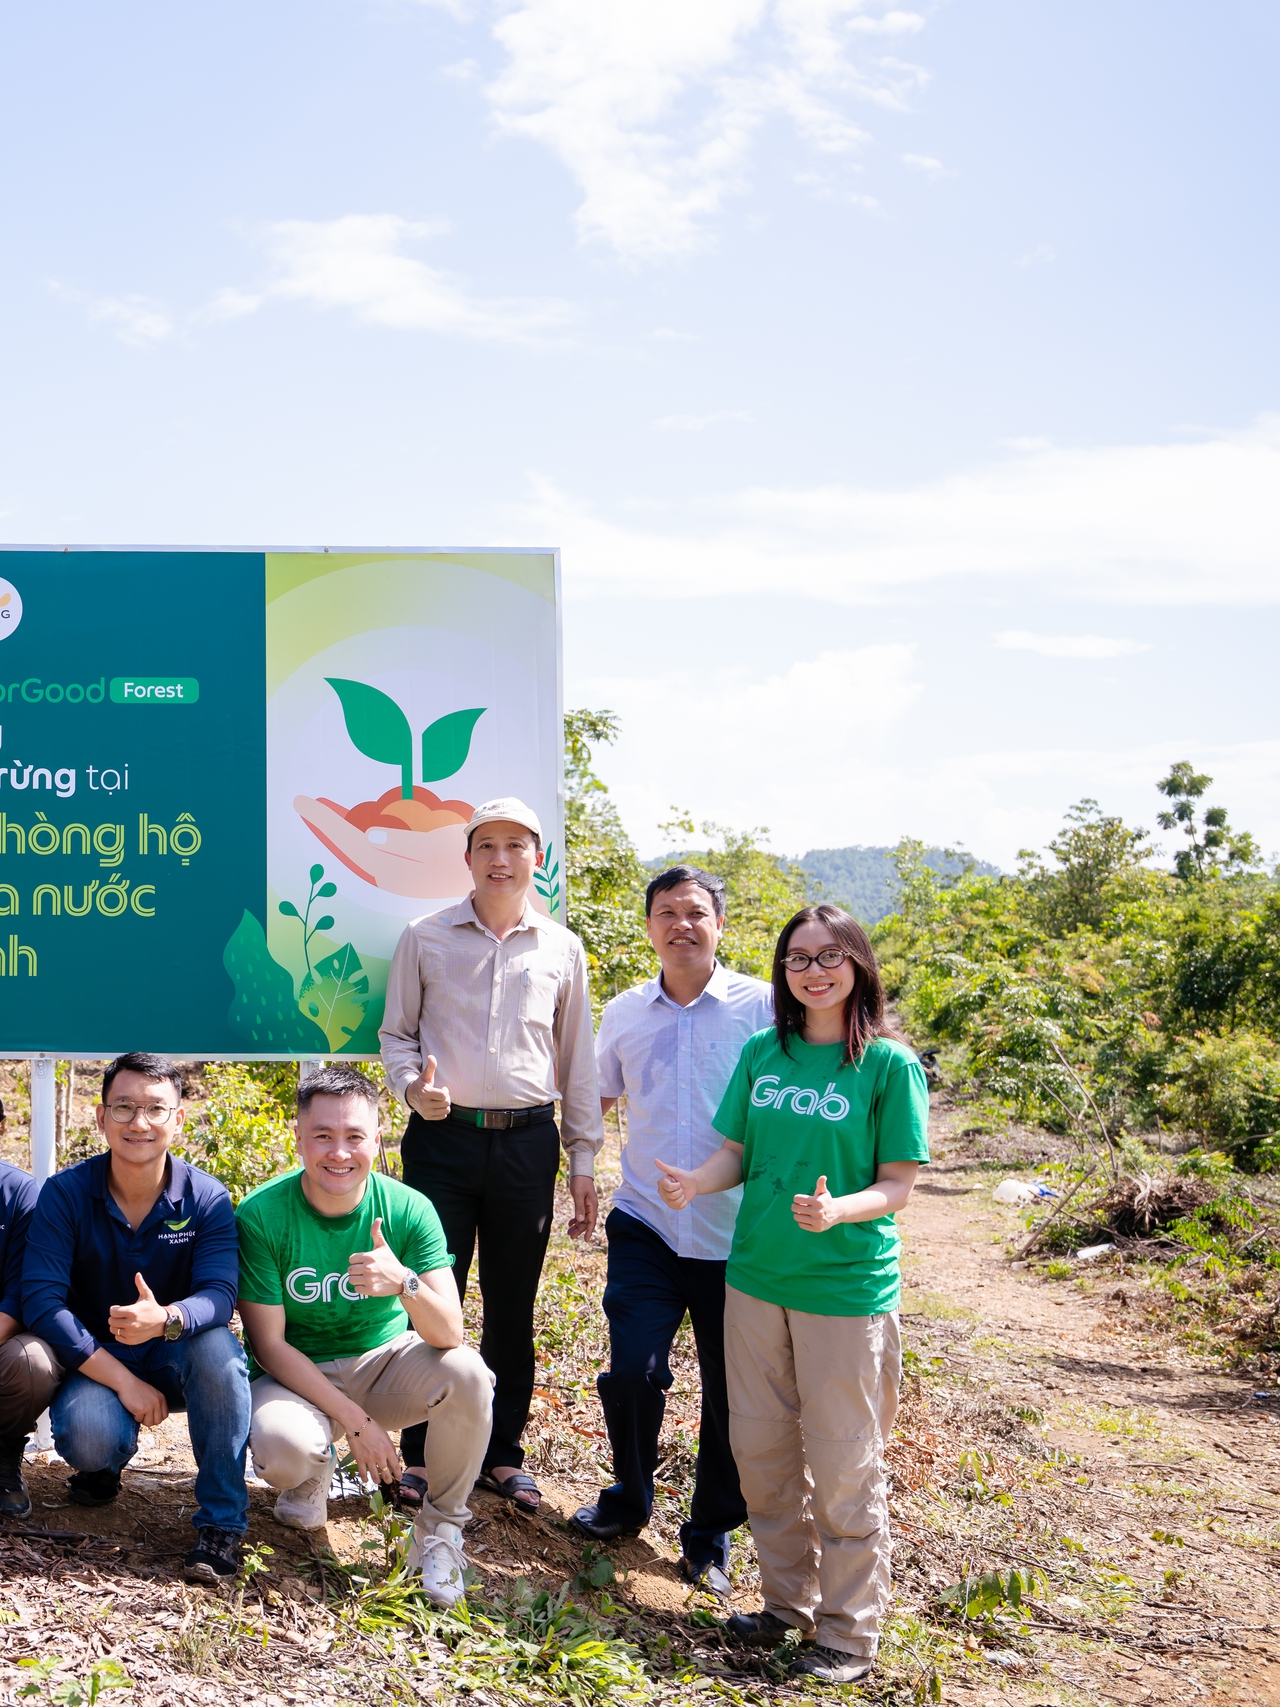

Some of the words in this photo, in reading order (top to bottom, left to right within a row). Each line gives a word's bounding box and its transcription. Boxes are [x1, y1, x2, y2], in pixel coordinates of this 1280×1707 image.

[124, 682, 184, 698] Forest
[86, 763, 129, 796] tại
[139, 812, 202, 866] hộ
[33, 873, 156, 917] nước
[751, 1074, 850, 1121] Grab
[169, 1237, 189, 1245] XANH
